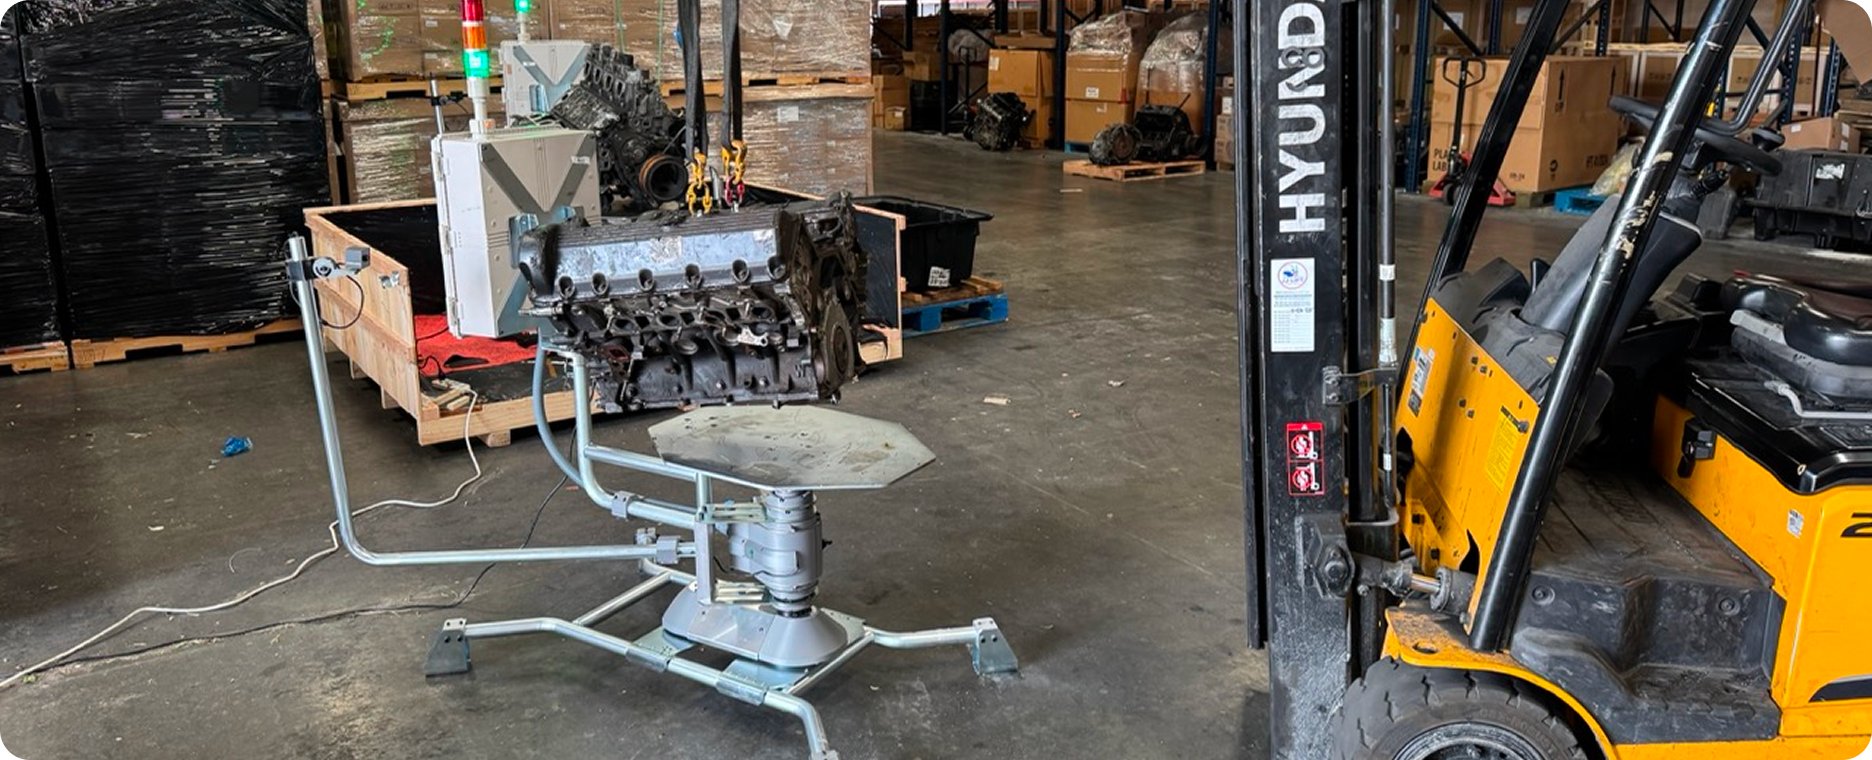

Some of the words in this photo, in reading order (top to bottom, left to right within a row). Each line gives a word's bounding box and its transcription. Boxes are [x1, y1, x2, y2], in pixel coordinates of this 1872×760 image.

[1278, 0, 1325, 233] HYUND
[1433, 148, 1449, 159] PLA
[1432, 161, 1448, 171] LAB
